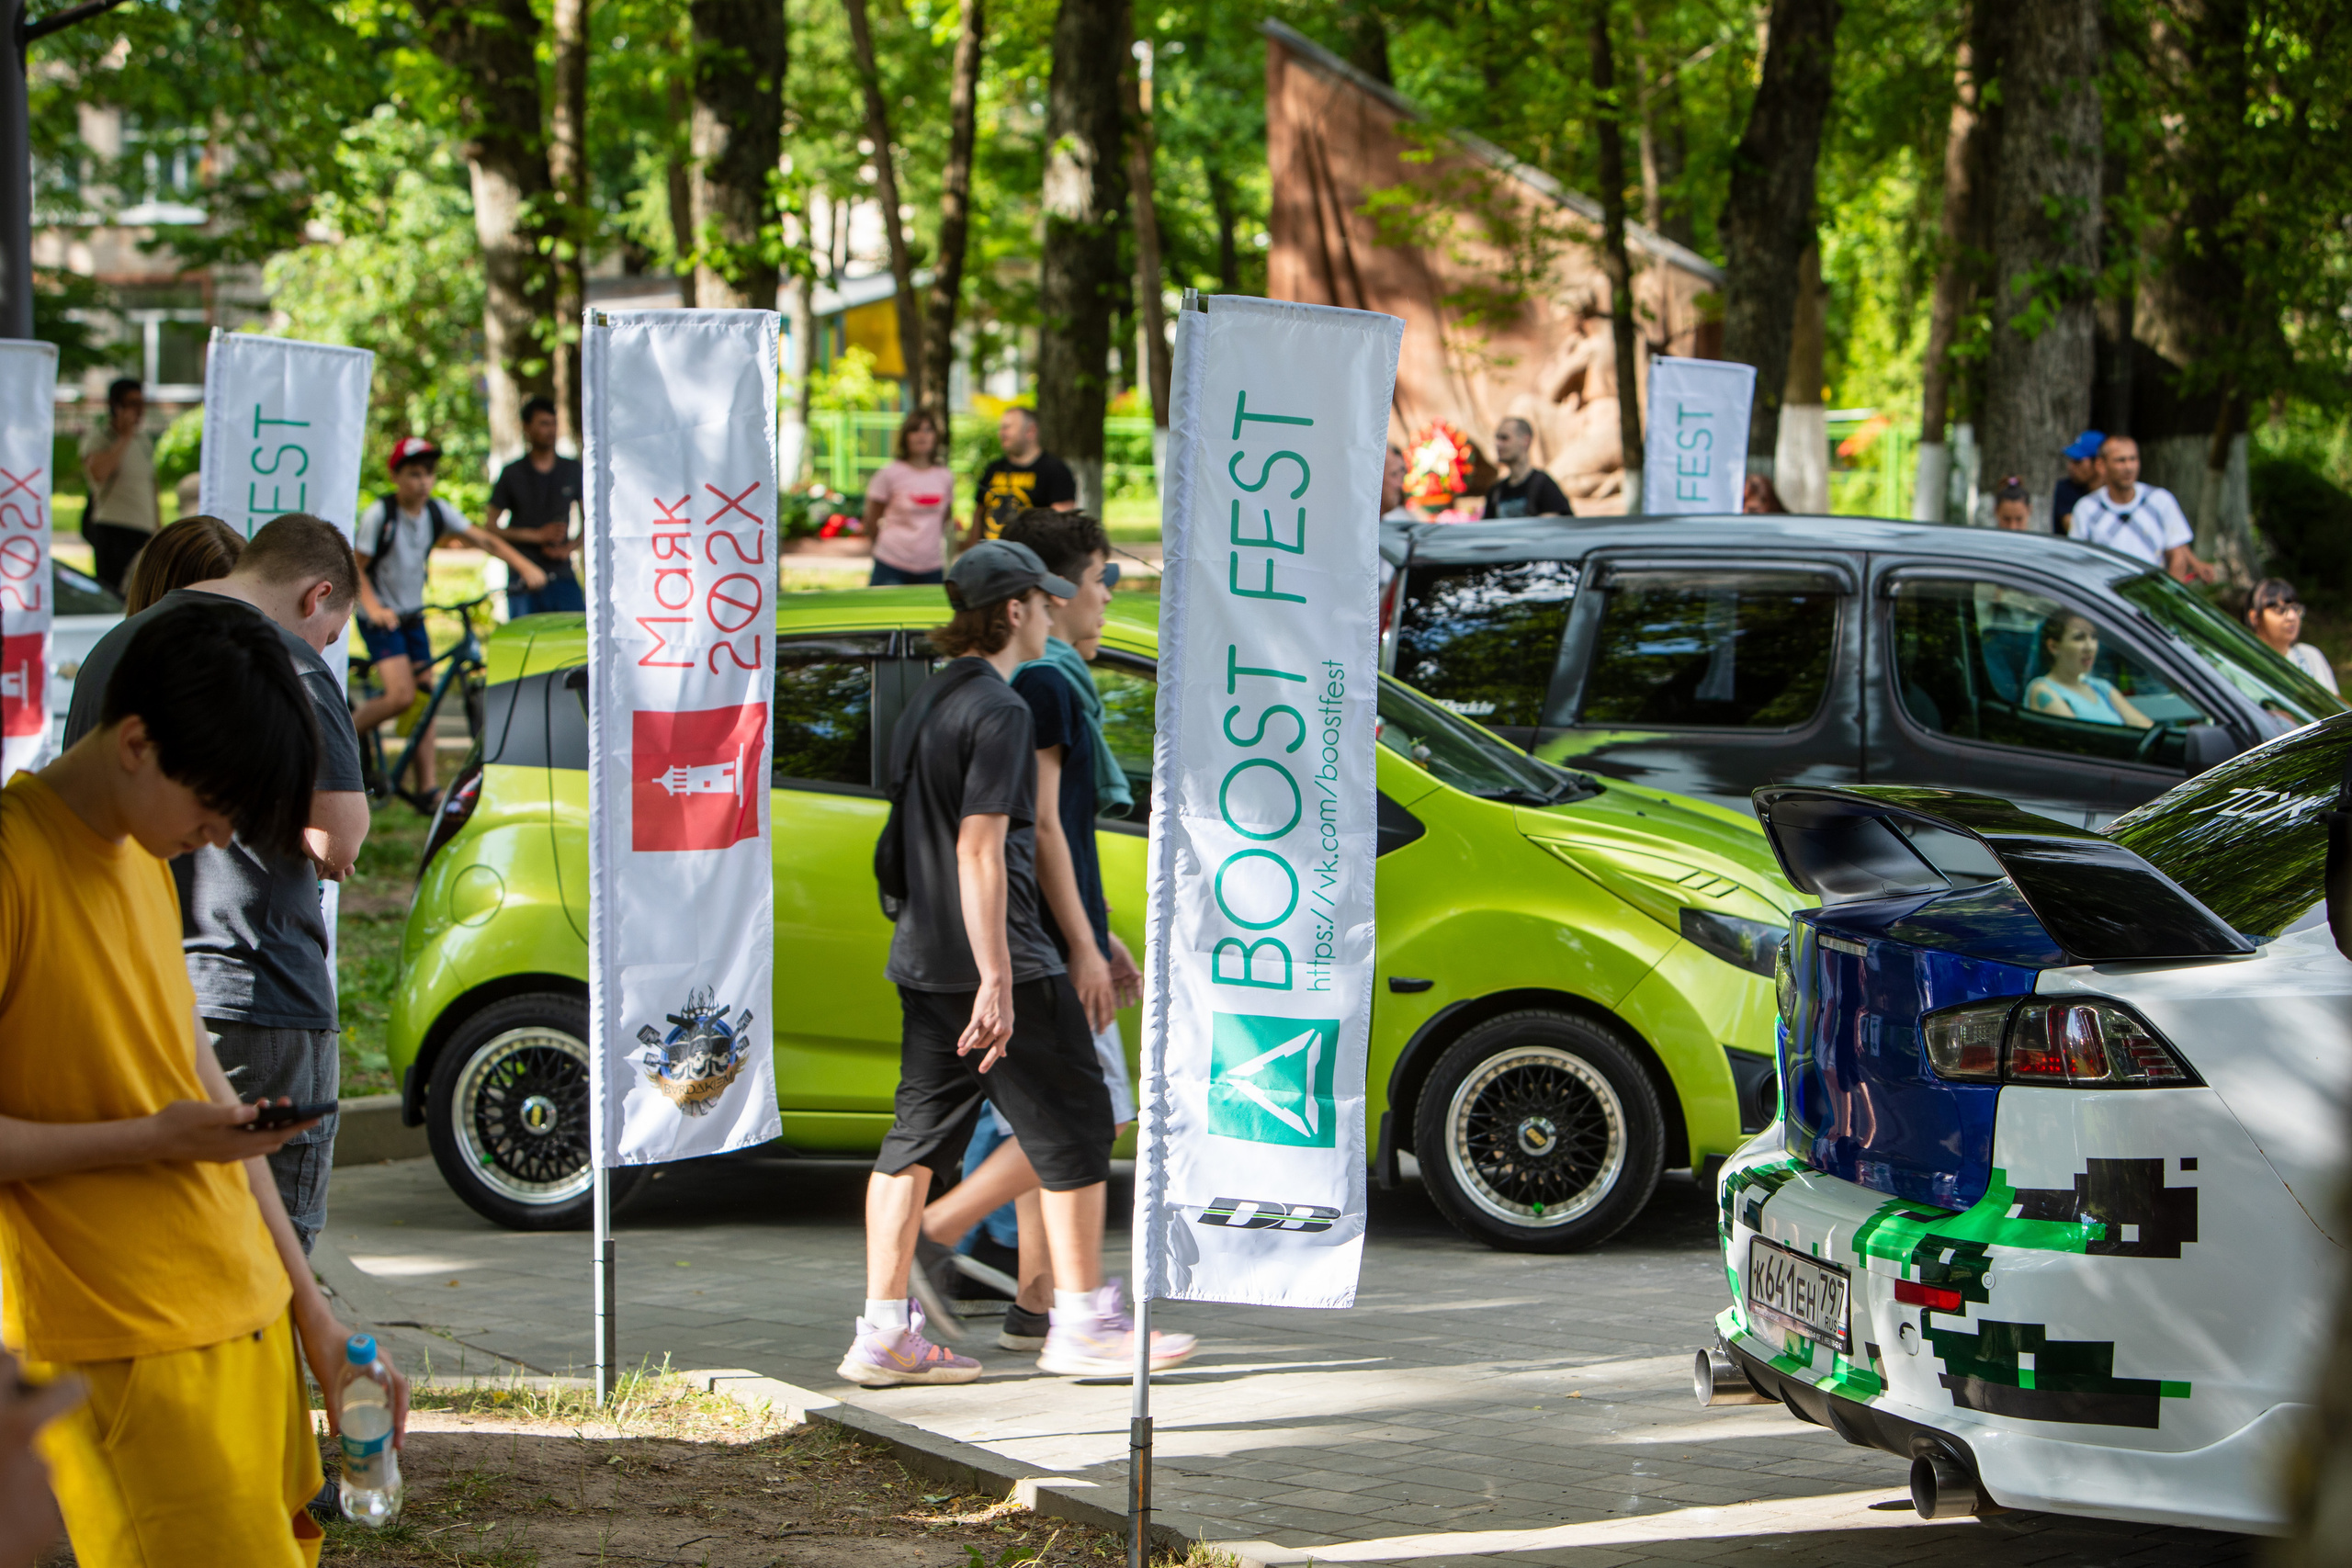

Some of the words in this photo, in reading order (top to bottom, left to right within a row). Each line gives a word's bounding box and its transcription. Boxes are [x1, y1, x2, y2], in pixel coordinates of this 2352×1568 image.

[1228, 389, 1315, 604] FEST
[1676, 401, 1714, 502] FEST
[636, 493, 695, 668] Маяк
[1211, 644, 1307, 991] BOOST
[1306, 659, 1345, 992] https://vk.com/boostfest
[1820, 1272, 1845, 1319] 797
[1824, 1315, 1838, 1333] RUS
